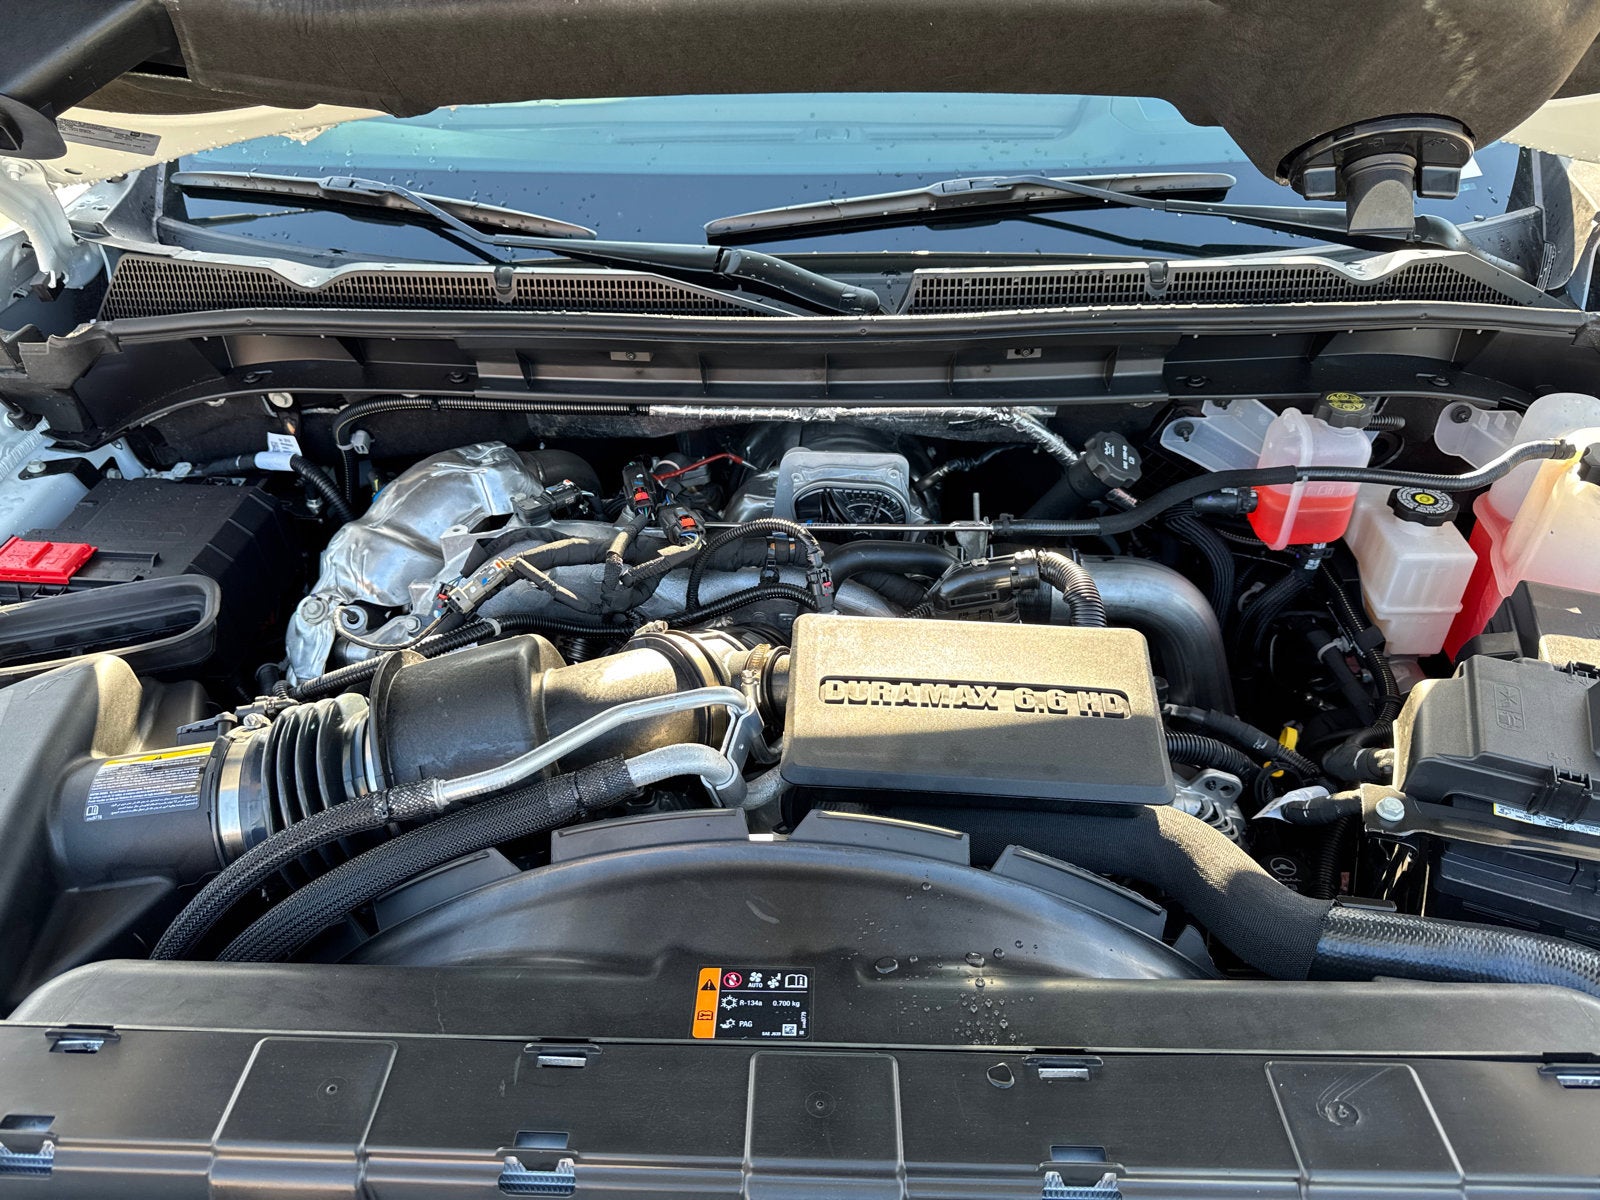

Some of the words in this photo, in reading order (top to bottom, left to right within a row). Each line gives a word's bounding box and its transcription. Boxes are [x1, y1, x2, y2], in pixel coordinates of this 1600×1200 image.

[823, 679, 999, 711] DURAMAX
[1013, 687, 1069, 714] 6.6
[1079, 691, 1127, 718] HD
[739, 999, 763, 1007] R-134a
[792, 1000, 801, 1008] kg
[739, 1020, 753, 1028] PAG
